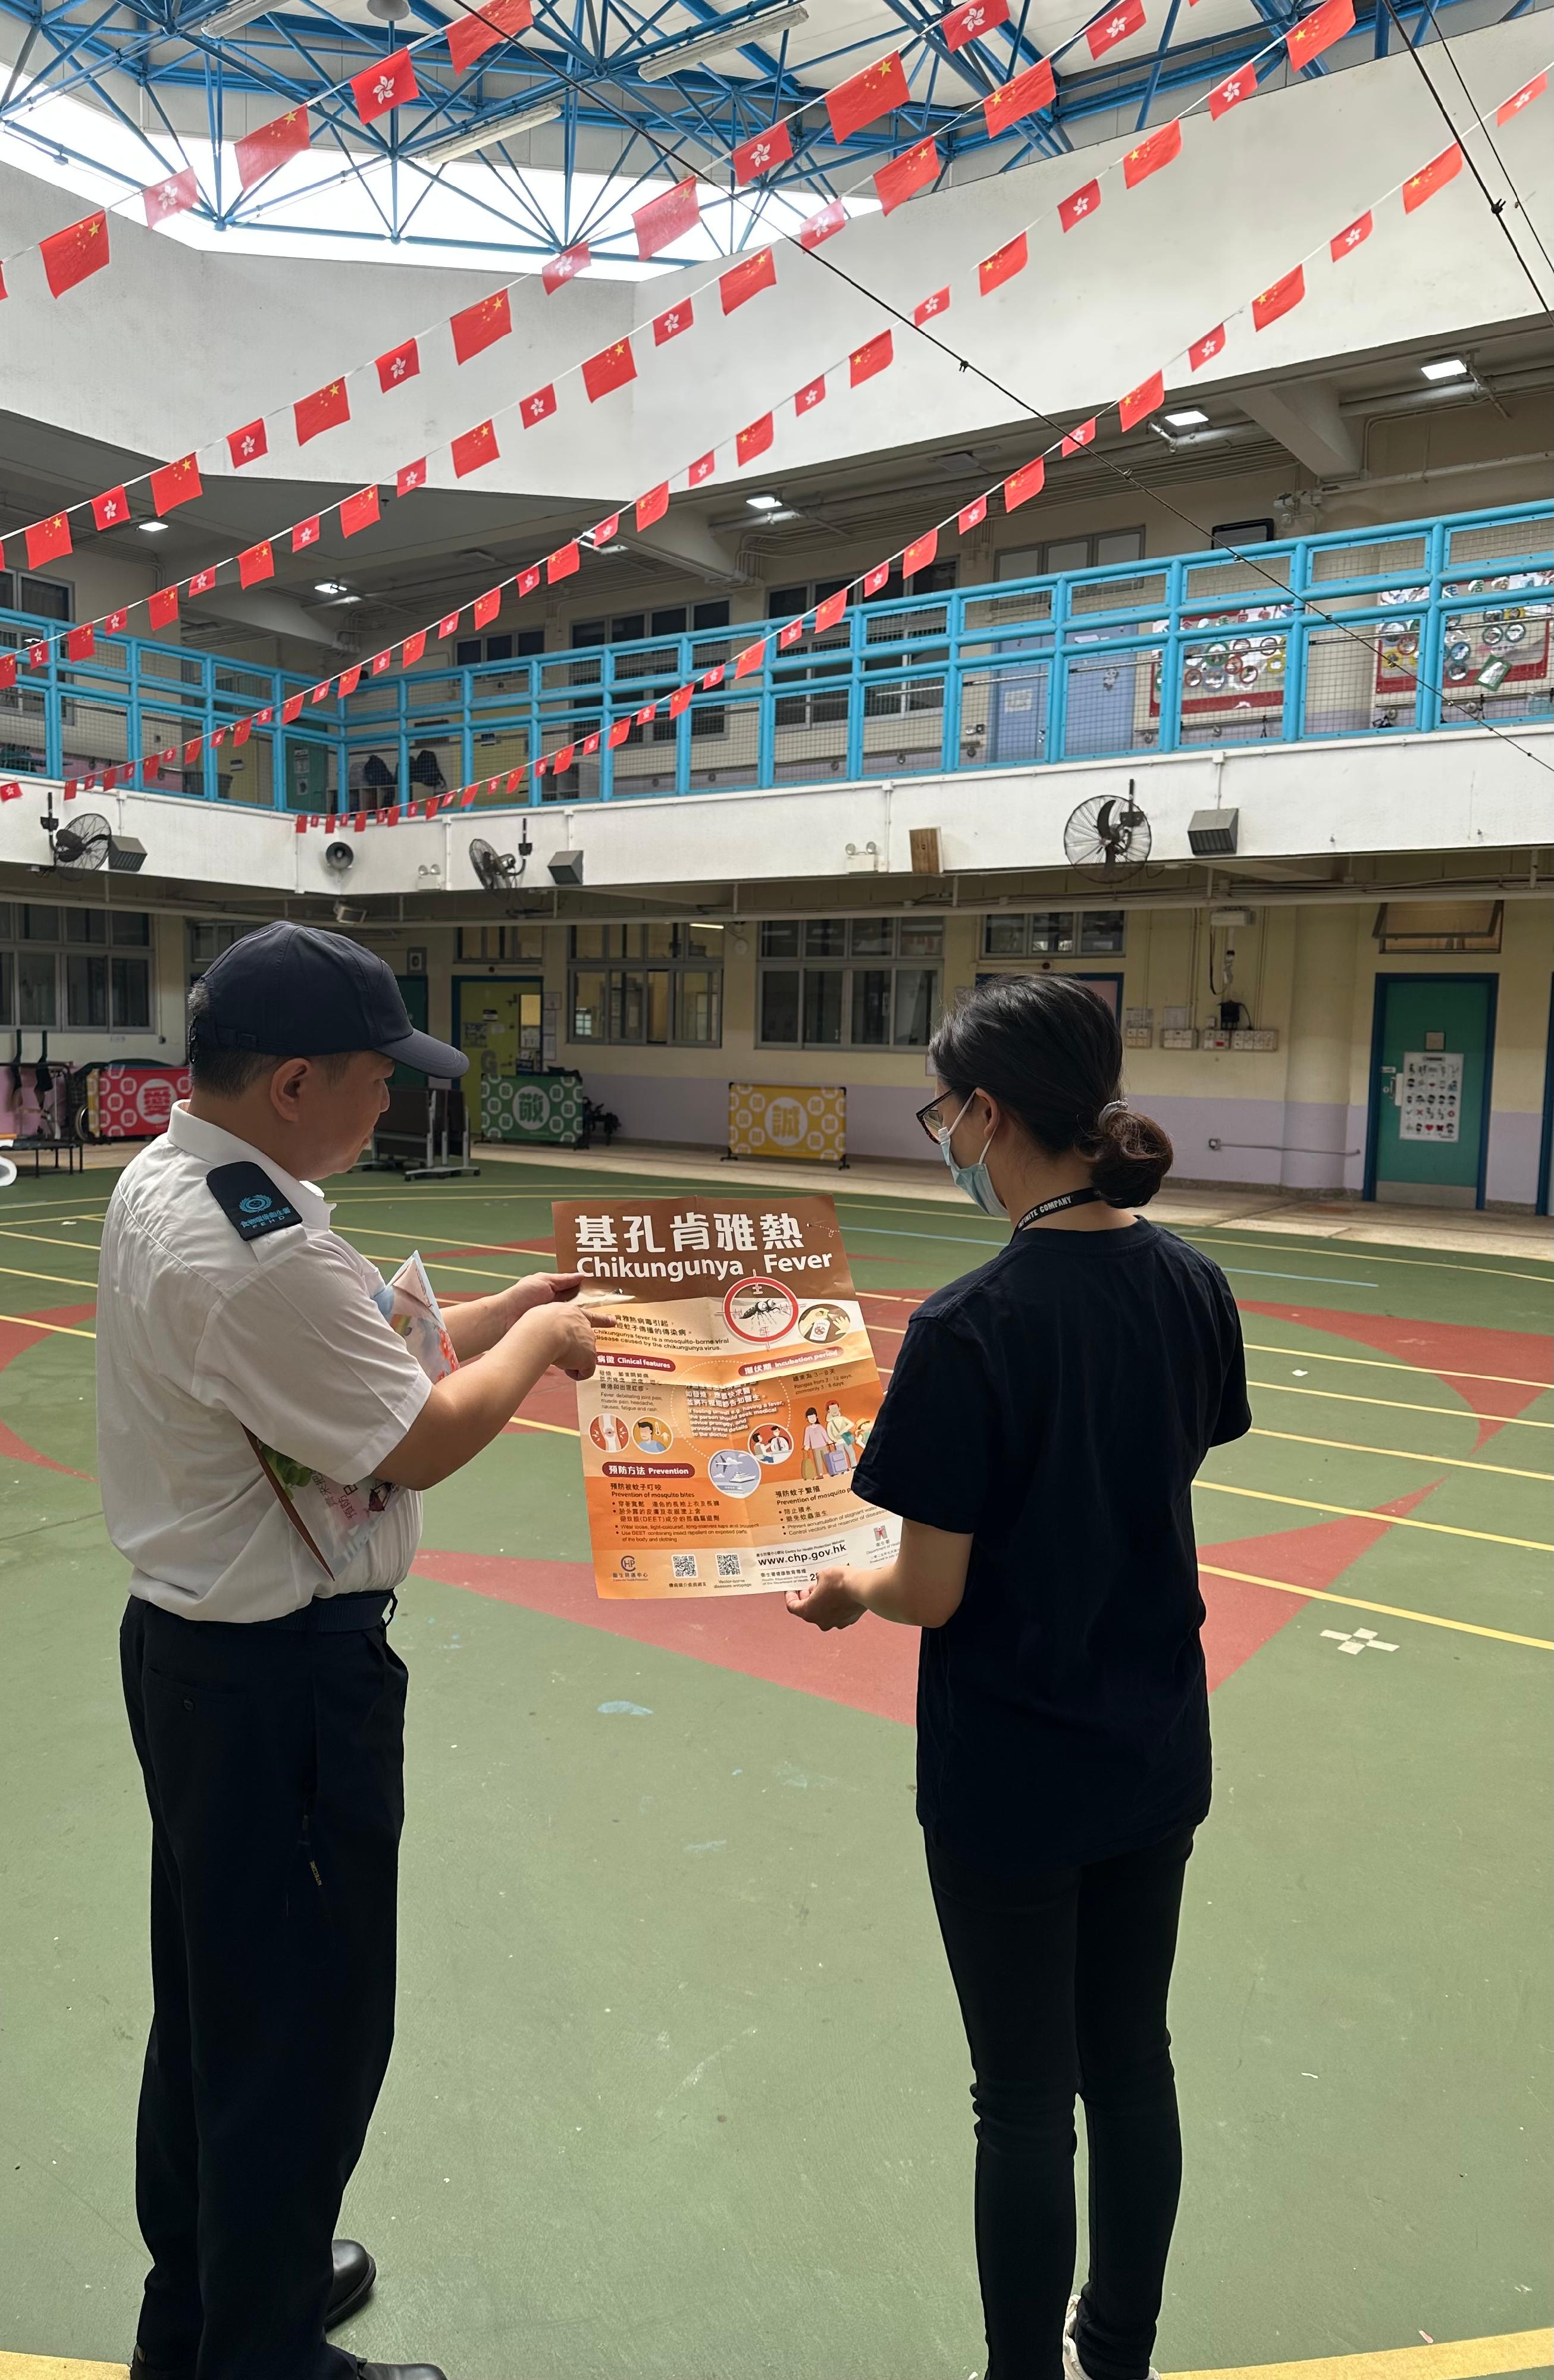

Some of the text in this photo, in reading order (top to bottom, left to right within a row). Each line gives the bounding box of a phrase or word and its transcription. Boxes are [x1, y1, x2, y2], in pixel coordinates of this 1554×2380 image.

[144, 1086, 171, 1116] 愛
[1018, 1195, 1071, 1229] INFINITE COMPANY
[575, 1211, 804, 1253] 基孔肯雅熱
[577, 1252, 832, 1282] Chikungunya Fever
[594, 1329, 634, 1338] Chikungunya
[643, 1360, 671, 1368] features
[775, 1356, 813, 1368] Incubation
[813, 1349, 838, 1361] period
[753, 1407, 777, 1416] medical
[729, 1424, 748, 1433] details
[608, 1465, 646, 1475] 預防方法
[776, 1496, 809, 1505] Prevention
[817, 1489, 846, 1499] mosquito
[758, 1543, 847, 1566] www.chp.gov.hk
[621, 1555, 636, 1571] CHP
